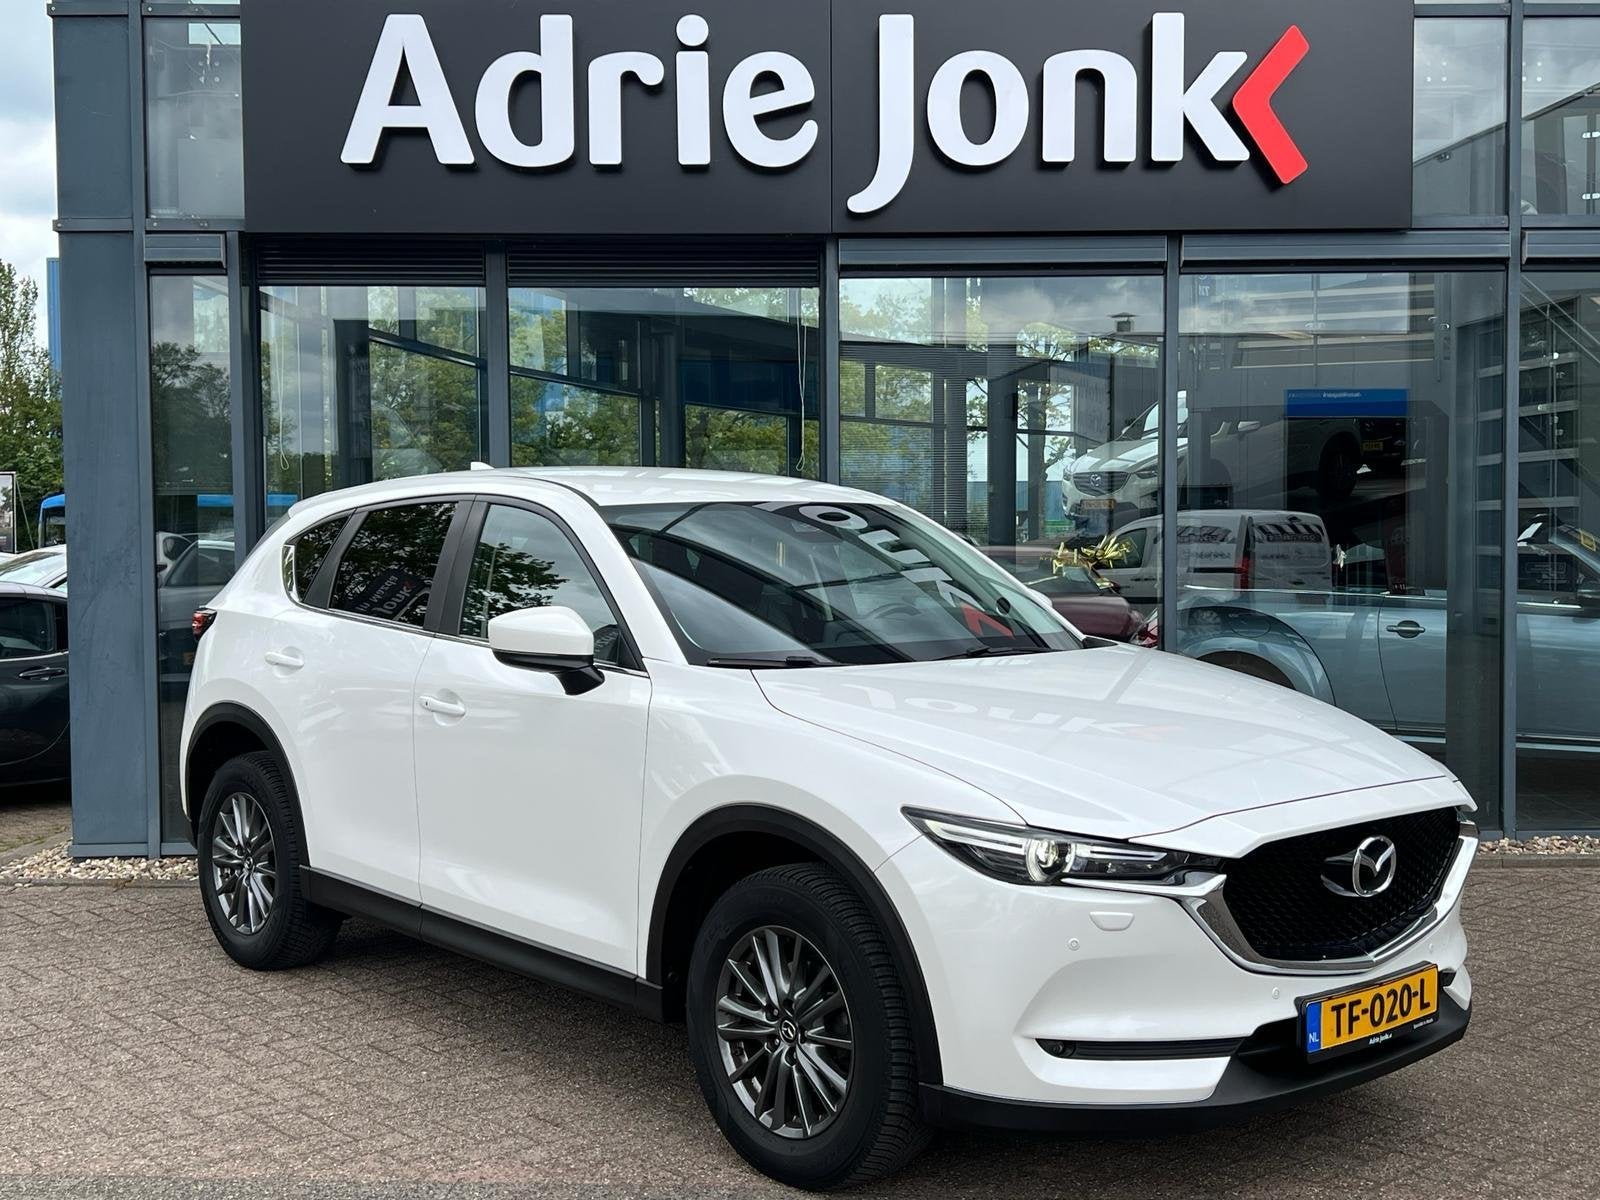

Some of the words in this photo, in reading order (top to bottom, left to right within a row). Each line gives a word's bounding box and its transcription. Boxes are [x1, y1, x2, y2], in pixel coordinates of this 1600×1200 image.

[340, 14, 818, 168] Adrie
[847, 12, 1250, 213] Jonk
[1309, 1032, 1319, 1043] NL
[1331, 978, 1430, 1038] TF-020-L
